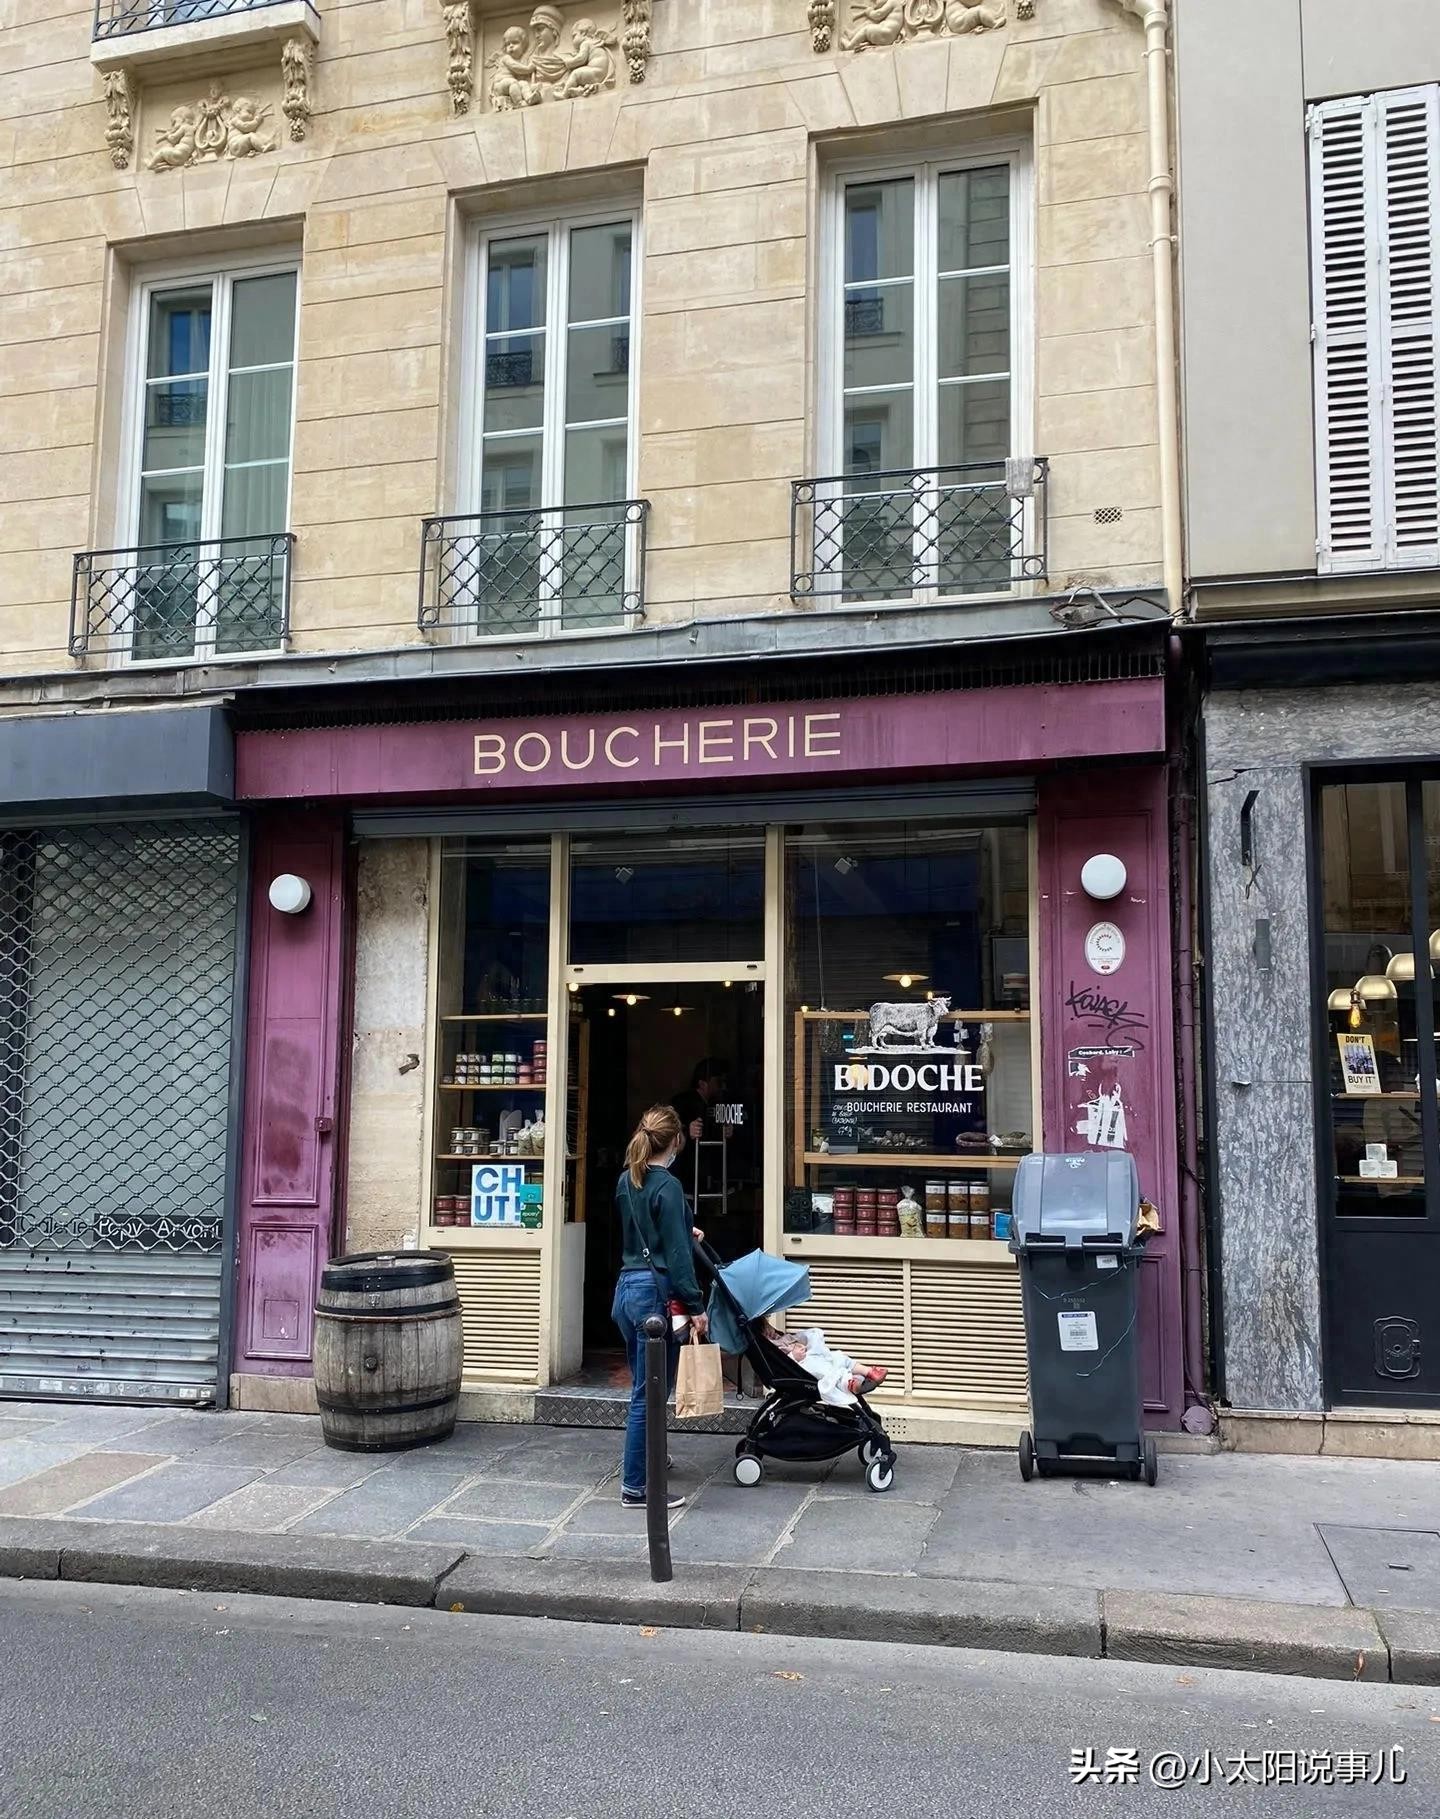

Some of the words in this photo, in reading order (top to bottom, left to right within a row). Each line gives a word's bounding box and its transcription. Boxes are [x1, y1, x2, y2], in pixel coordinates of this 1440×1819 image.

[473, 712, 841, 775] BOUCHERIE
[834, 1064, 984, 1091] BIDOCHE
[1347, 1075, 1363, 1084] BUY
[715, 1103, 744, 1125] BIDOCHE
[847, 1101, 903, 1113] BOUCHERIE
[906, 1101, 972, 1113] RESTAURANT
[475, 1167, 522, 1193] CH
[21, 1213, 88, 1234] Galeie
